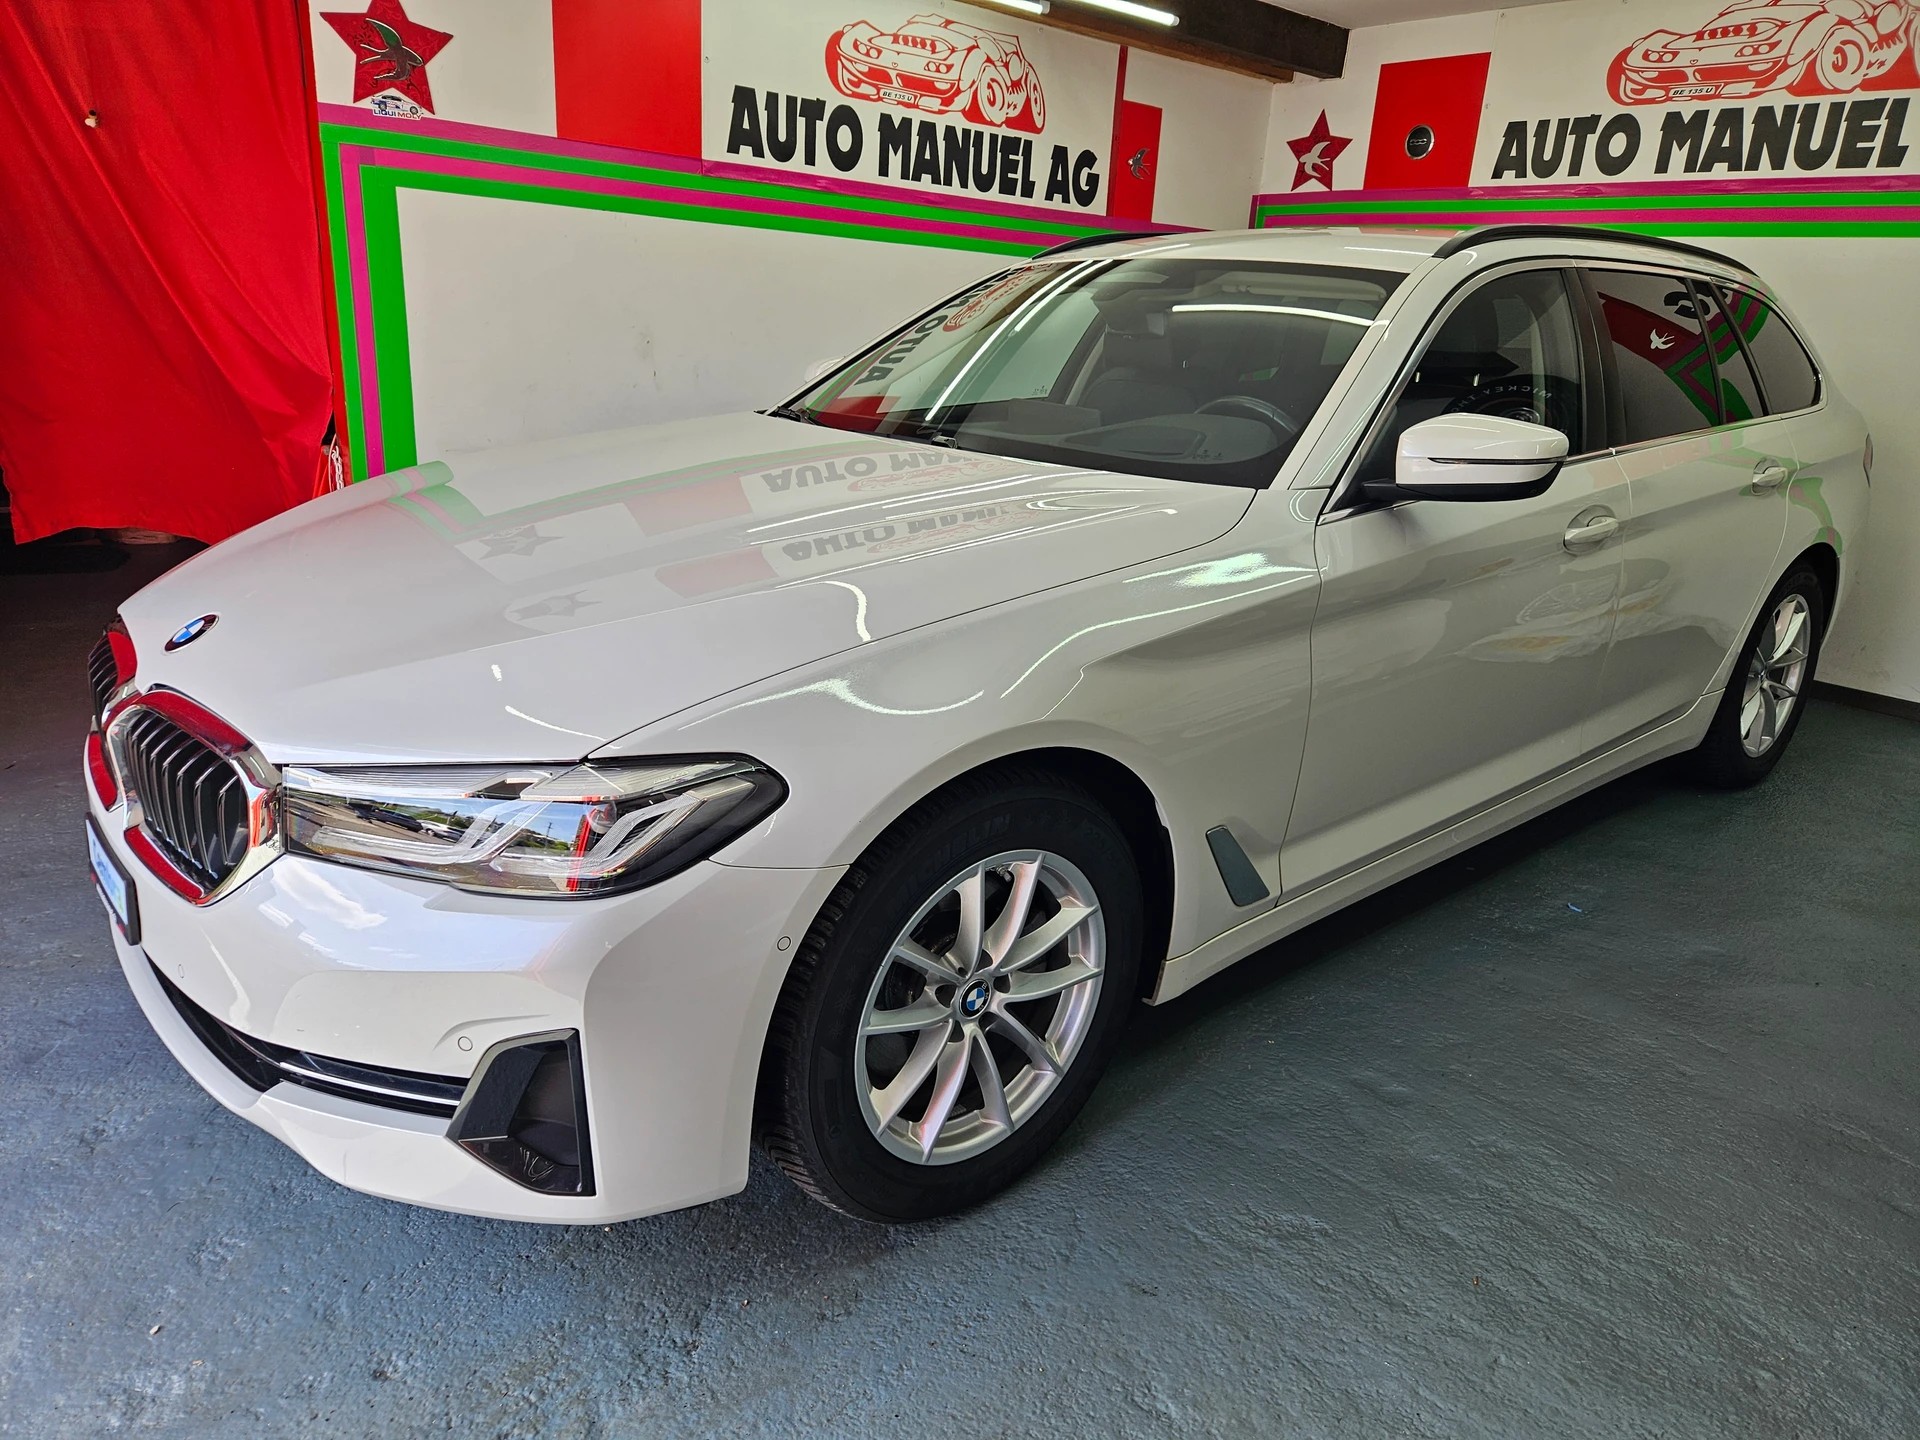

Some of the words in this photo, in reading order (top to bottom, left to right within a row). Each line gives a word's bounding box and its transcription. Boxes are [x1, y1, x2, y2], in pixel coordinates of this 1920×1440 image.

[1688, 87, 1705, 95] 135
[1705, 86, 1714, 94] U
[894, 93, 906, 101] 135
[373, 109, 397, 117] LIQUI
[397, 111, 421, 119] MOLY
[1491, 112, 1642, 180] AUTO
[1653, 96, 1912, 175] MANUEL
[727, 84, 864, 173] AUTO
[877, 112, 1036, 199] MANUEL
[1044, 144, 1100, 208] AG
